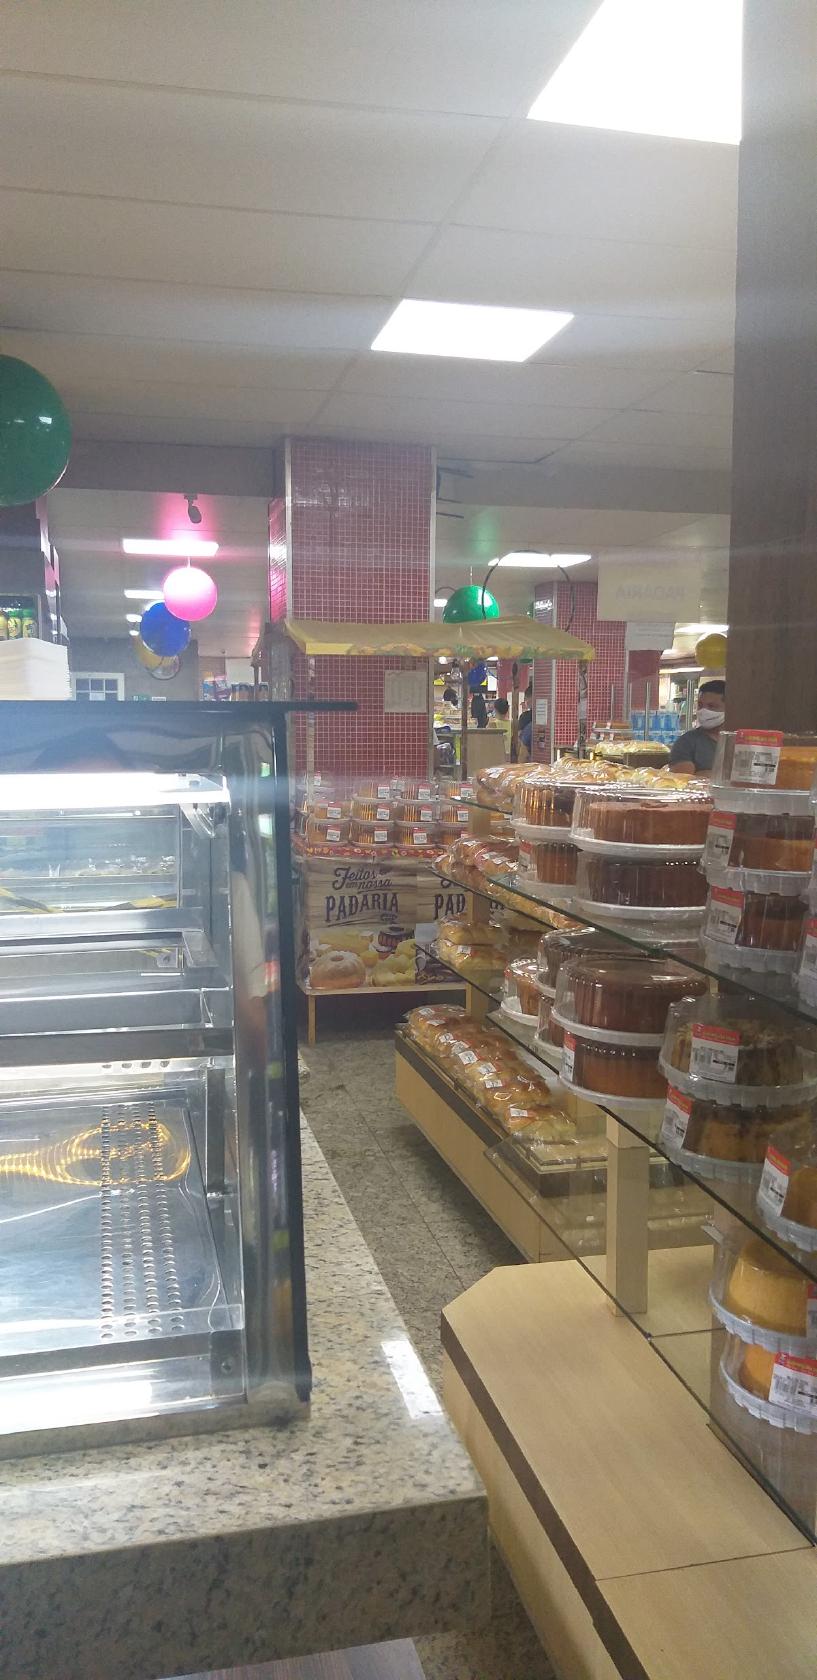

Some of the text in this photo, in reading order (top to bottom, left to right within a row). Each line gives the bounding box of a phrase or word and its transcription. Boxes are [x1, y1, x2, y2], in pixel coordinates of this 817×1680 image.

[332, 866, 376, 890] Feitos
[357, 880, 392, 890] nossa
[325, 893, 398, 922] PADARIA
